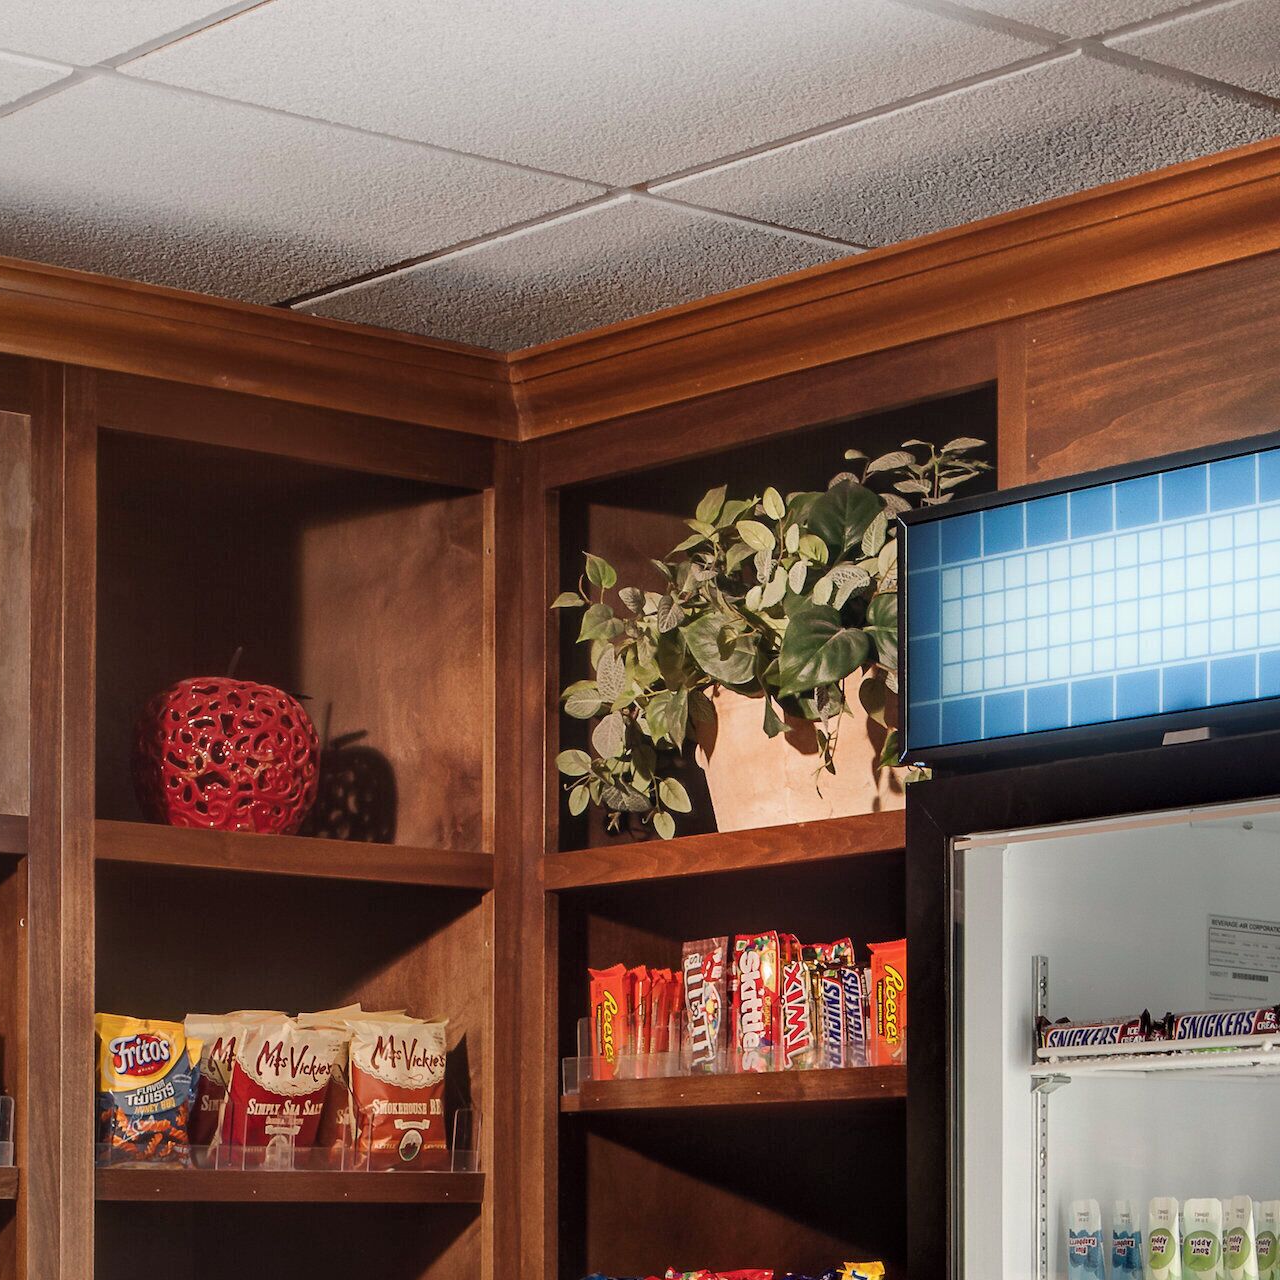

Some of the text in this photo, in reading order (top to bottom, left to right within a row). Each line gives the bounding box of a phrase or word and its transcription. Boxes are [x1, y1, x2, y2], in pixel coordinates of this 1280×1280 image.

[738, 950, 768, 1073] Skittles
[782, 960, 813, 1070] TWIX
[883, 963, 905, 1047] Reese's
[603, 988, 619, 1064] Reese's
[1048, 1026, 1119, 1048] SNICKERS
[1177, 1010, 1256, 1040] SNICKERS
[109, 1034, 170, 1075] Fritos
[291, 1044, 333, 1082] Vickie's
[402, 1037, 446, 1075] Vickie's
[125, 1081, 175, 1107] TWISTS
[136, 1079, 166, 1096] FLAVOR
[134, 1097, 177, 1115] HONEY BBQ
[246, 1097, 281, 1116] SIMPLY
[371, 1098, 428, 1116] SMOKEHOUSE
[1189, 1238, 1213, 1248] Apple
[1191, 1246, 1211, 1256] Sour
